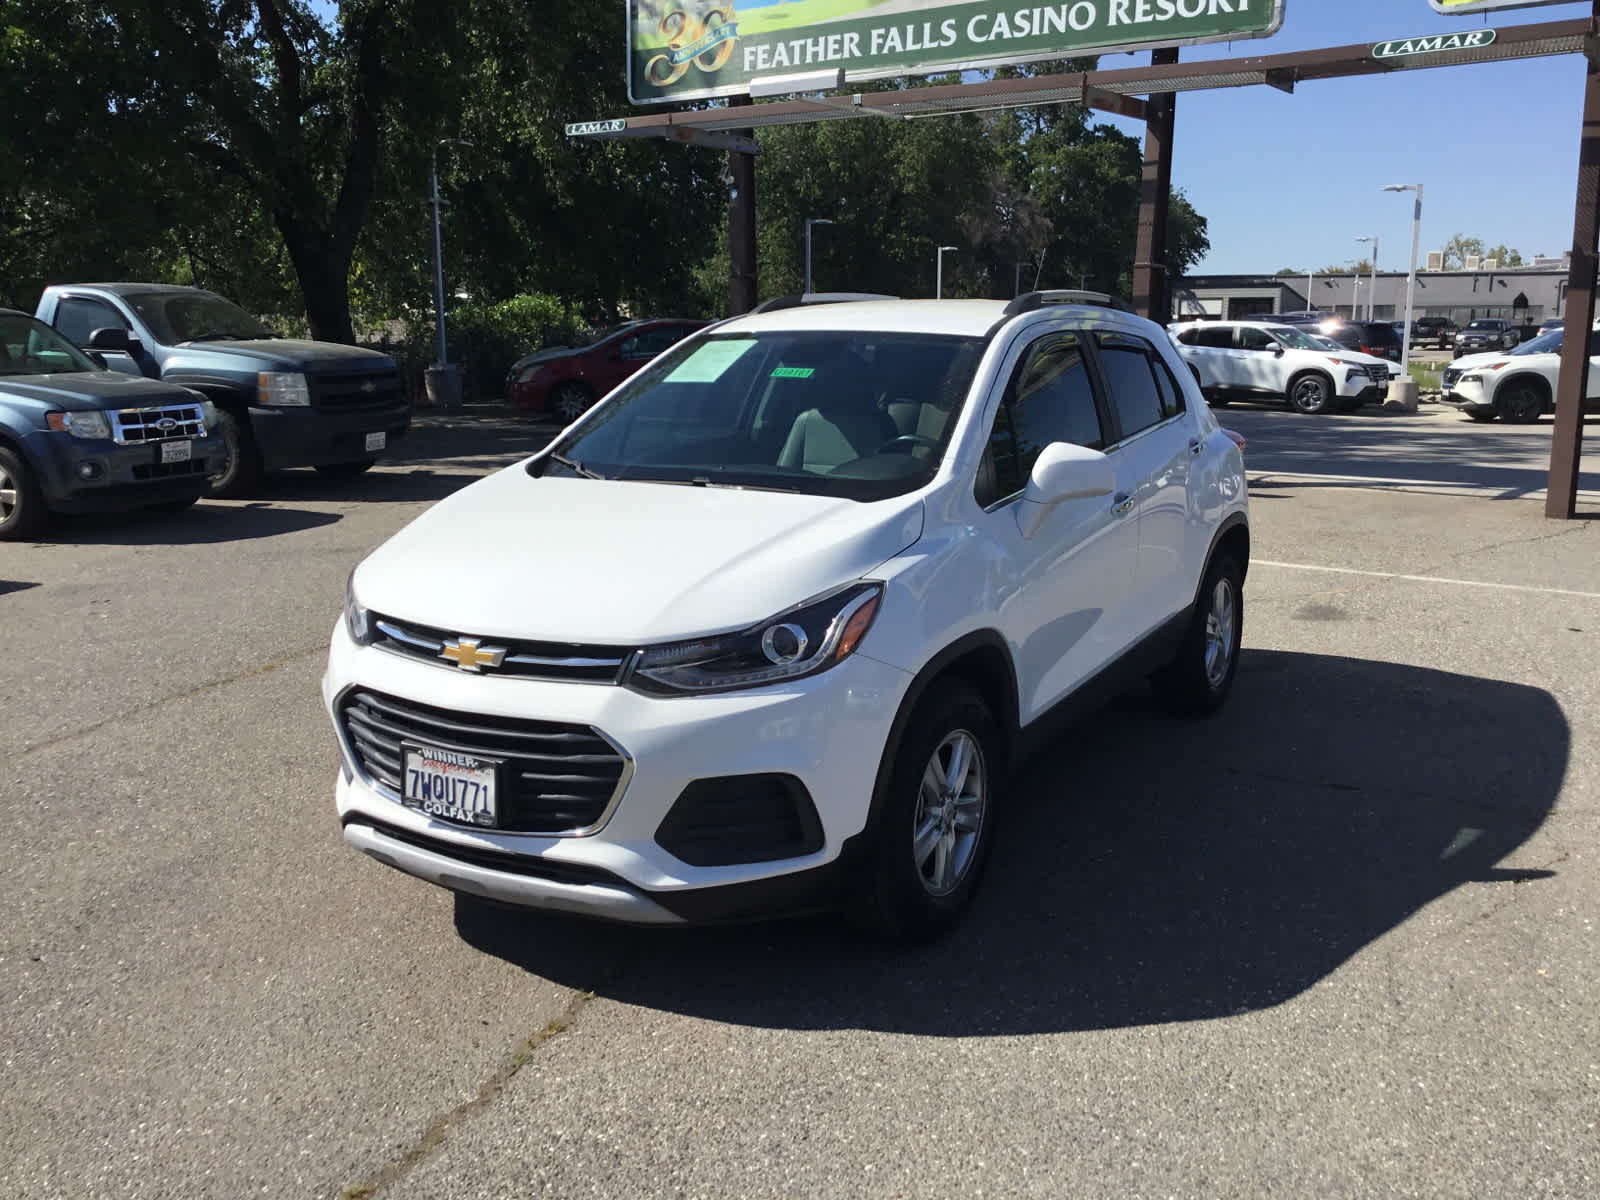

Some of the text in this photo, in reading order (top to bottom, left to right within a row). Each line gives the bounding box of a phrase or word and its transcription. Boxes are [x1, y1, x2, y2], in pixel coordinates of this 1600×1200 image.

[743, 32, 862, 71] FEATHER
[870, 19, 957, 56] FALLS
[967, 1, 1096, 42] CASINO
[1382, 32, 1483, 56] LAMAR
[570, 121, 620, 134] LAMAR
[422, 748, 475, 768] WINNER
[408, 768, 491, 815] 7WQU771
[423, 801, 475, 823] COLFAX
